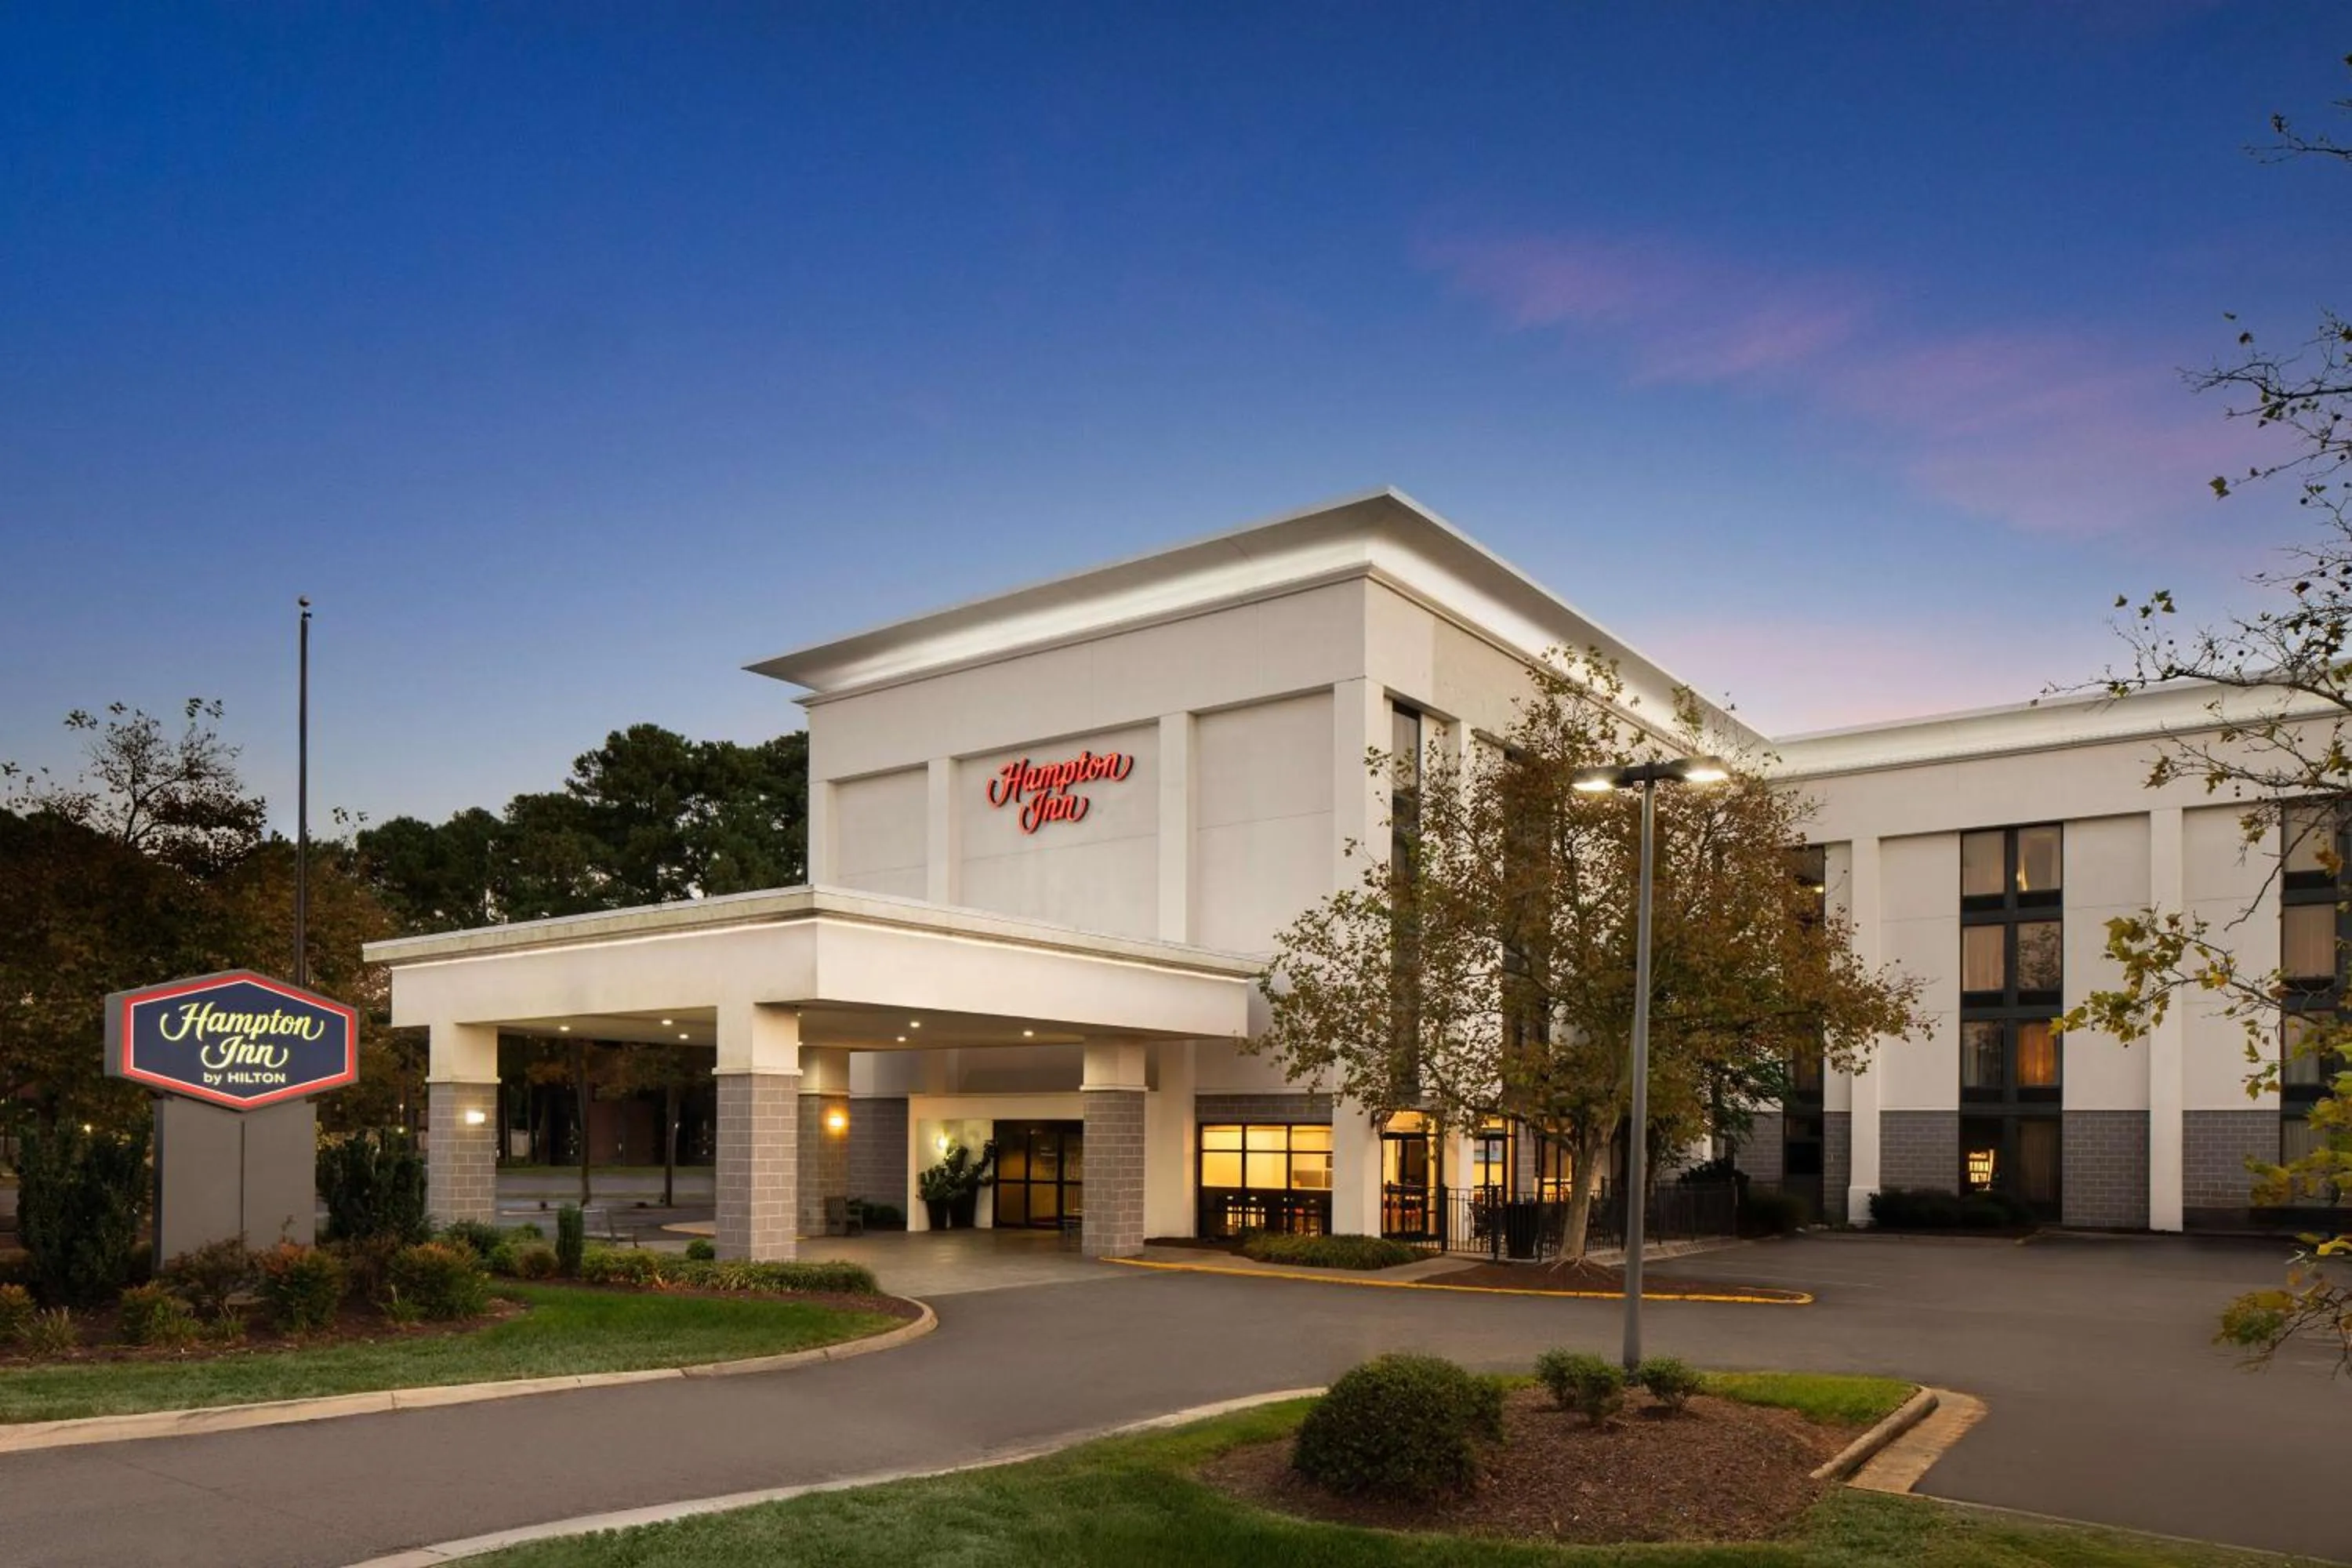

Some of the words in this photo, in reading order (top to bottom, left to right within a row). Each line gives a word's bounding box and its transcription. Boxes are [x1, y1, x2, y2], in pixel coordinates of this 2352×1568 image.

[987, 751, 1133, 808] Hampton
[1019, 790, 1089, 833] Inn
[160, 1002, 324, 1040] Hampton
[201, 1036, 288, 1068] Inn
[203, 1072, 222, 1085] by
[227, 1072, 286, 1083] HILTON
